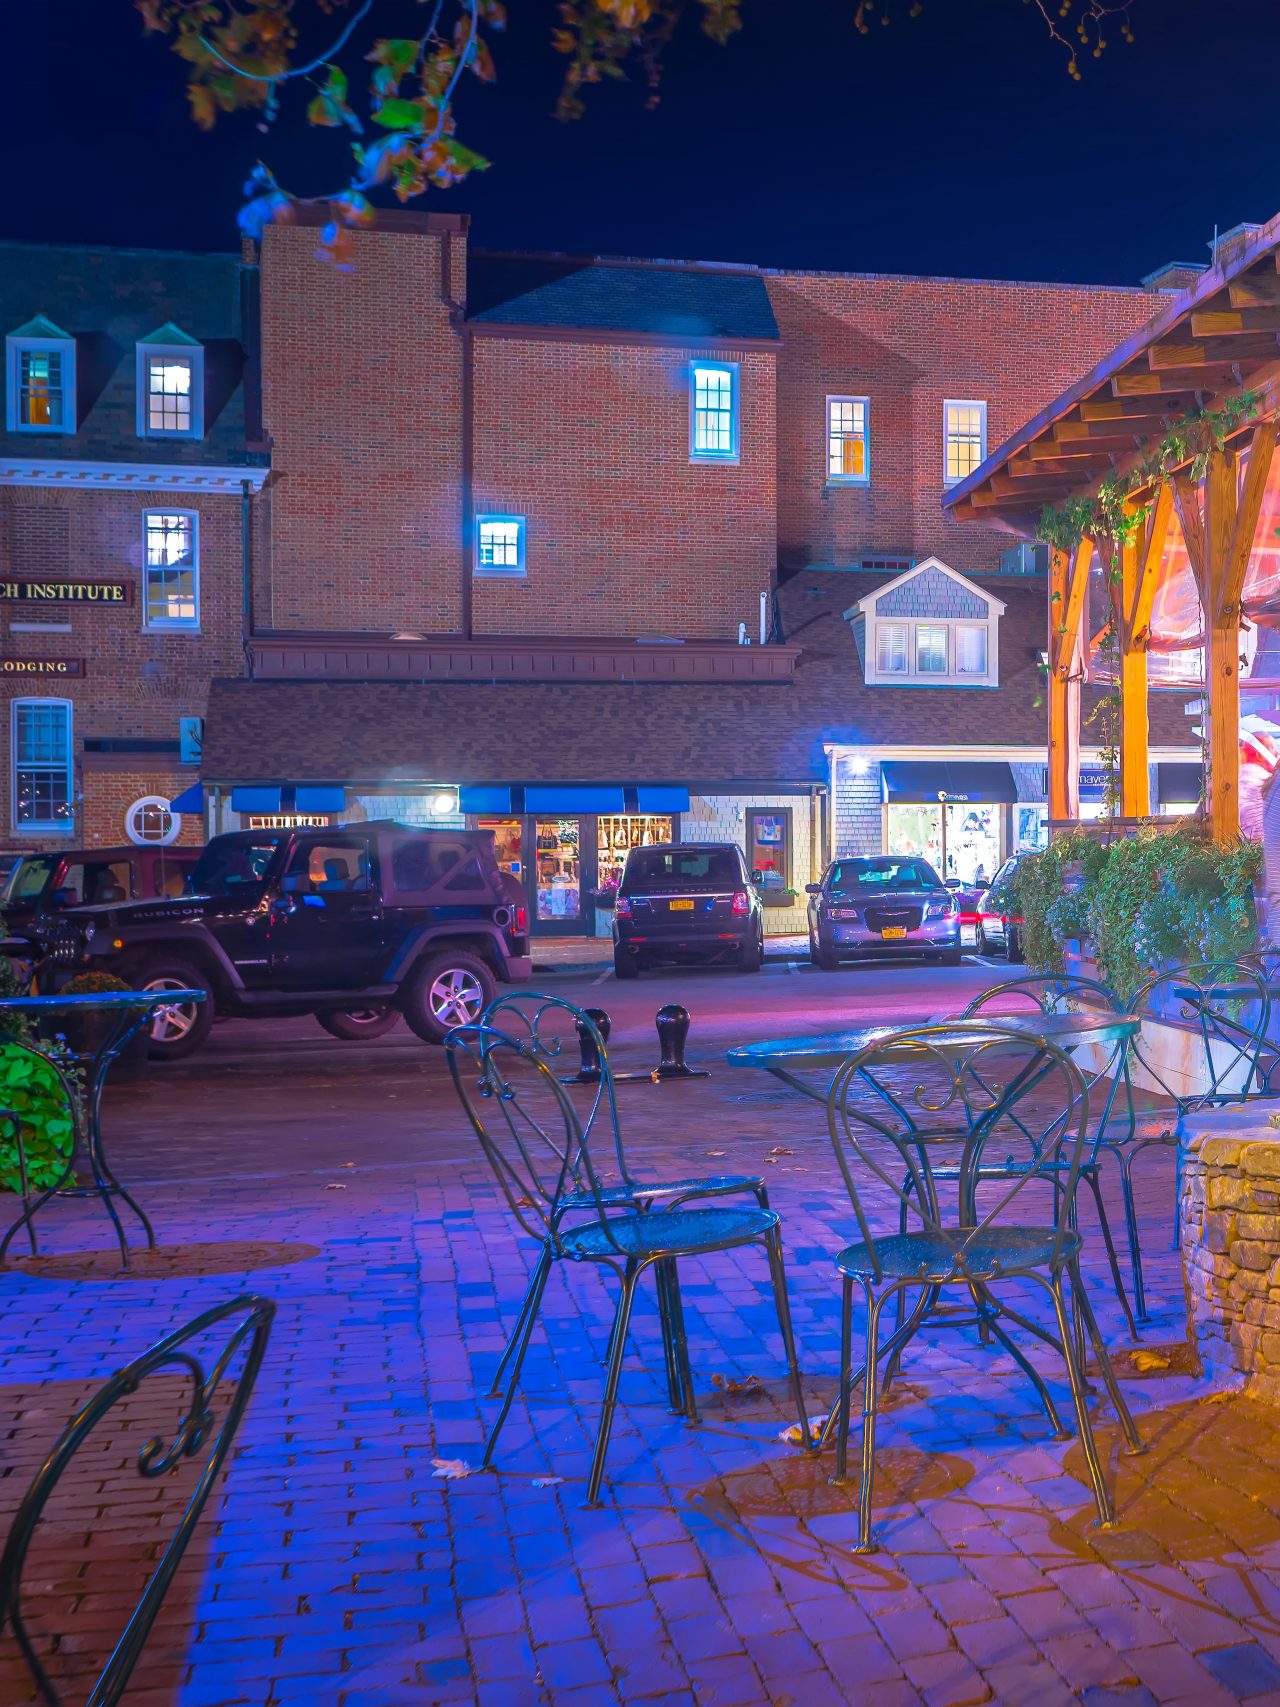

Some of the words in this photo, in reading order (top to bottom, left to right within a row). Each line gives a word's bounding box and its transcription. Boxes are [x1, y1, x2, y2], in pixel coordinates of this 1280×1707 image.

[26, 584, 124, 600] INSTITUTE
[0, 662, 67, 672] ODGING
[133, 908, 205, 918] RUBICON
